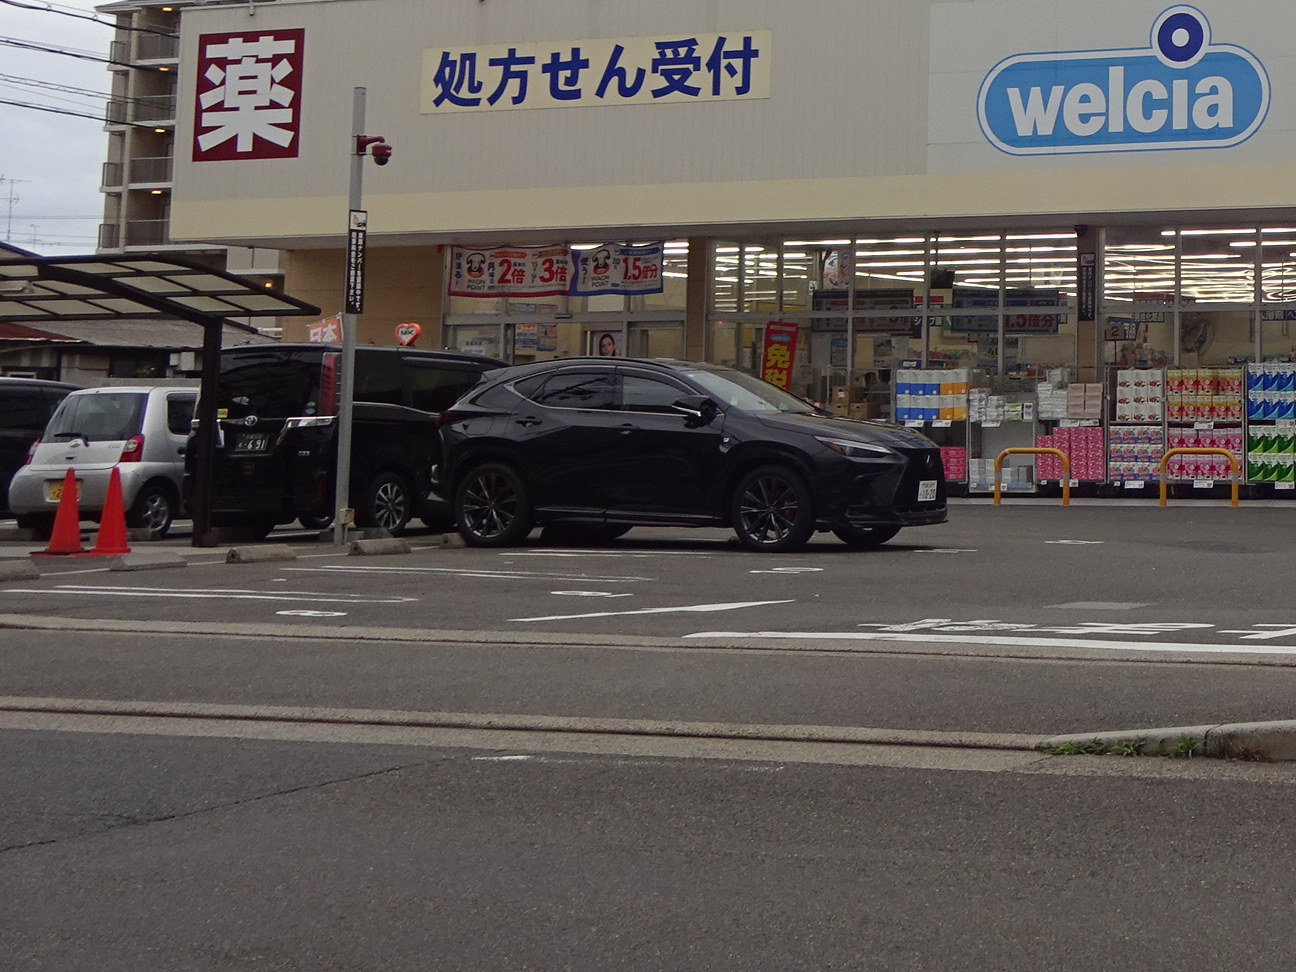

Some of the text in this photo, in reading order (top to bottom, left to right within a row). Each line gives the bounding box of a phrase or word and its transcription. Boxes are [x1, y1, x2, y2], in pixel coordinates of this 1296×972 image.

[197, 36, 295, 153] 薬
[432, 35, 760, 108] 処方せん受付
[1006, 13, 1234, 137] welcia
[1111, 326, 1119, 336] 2
